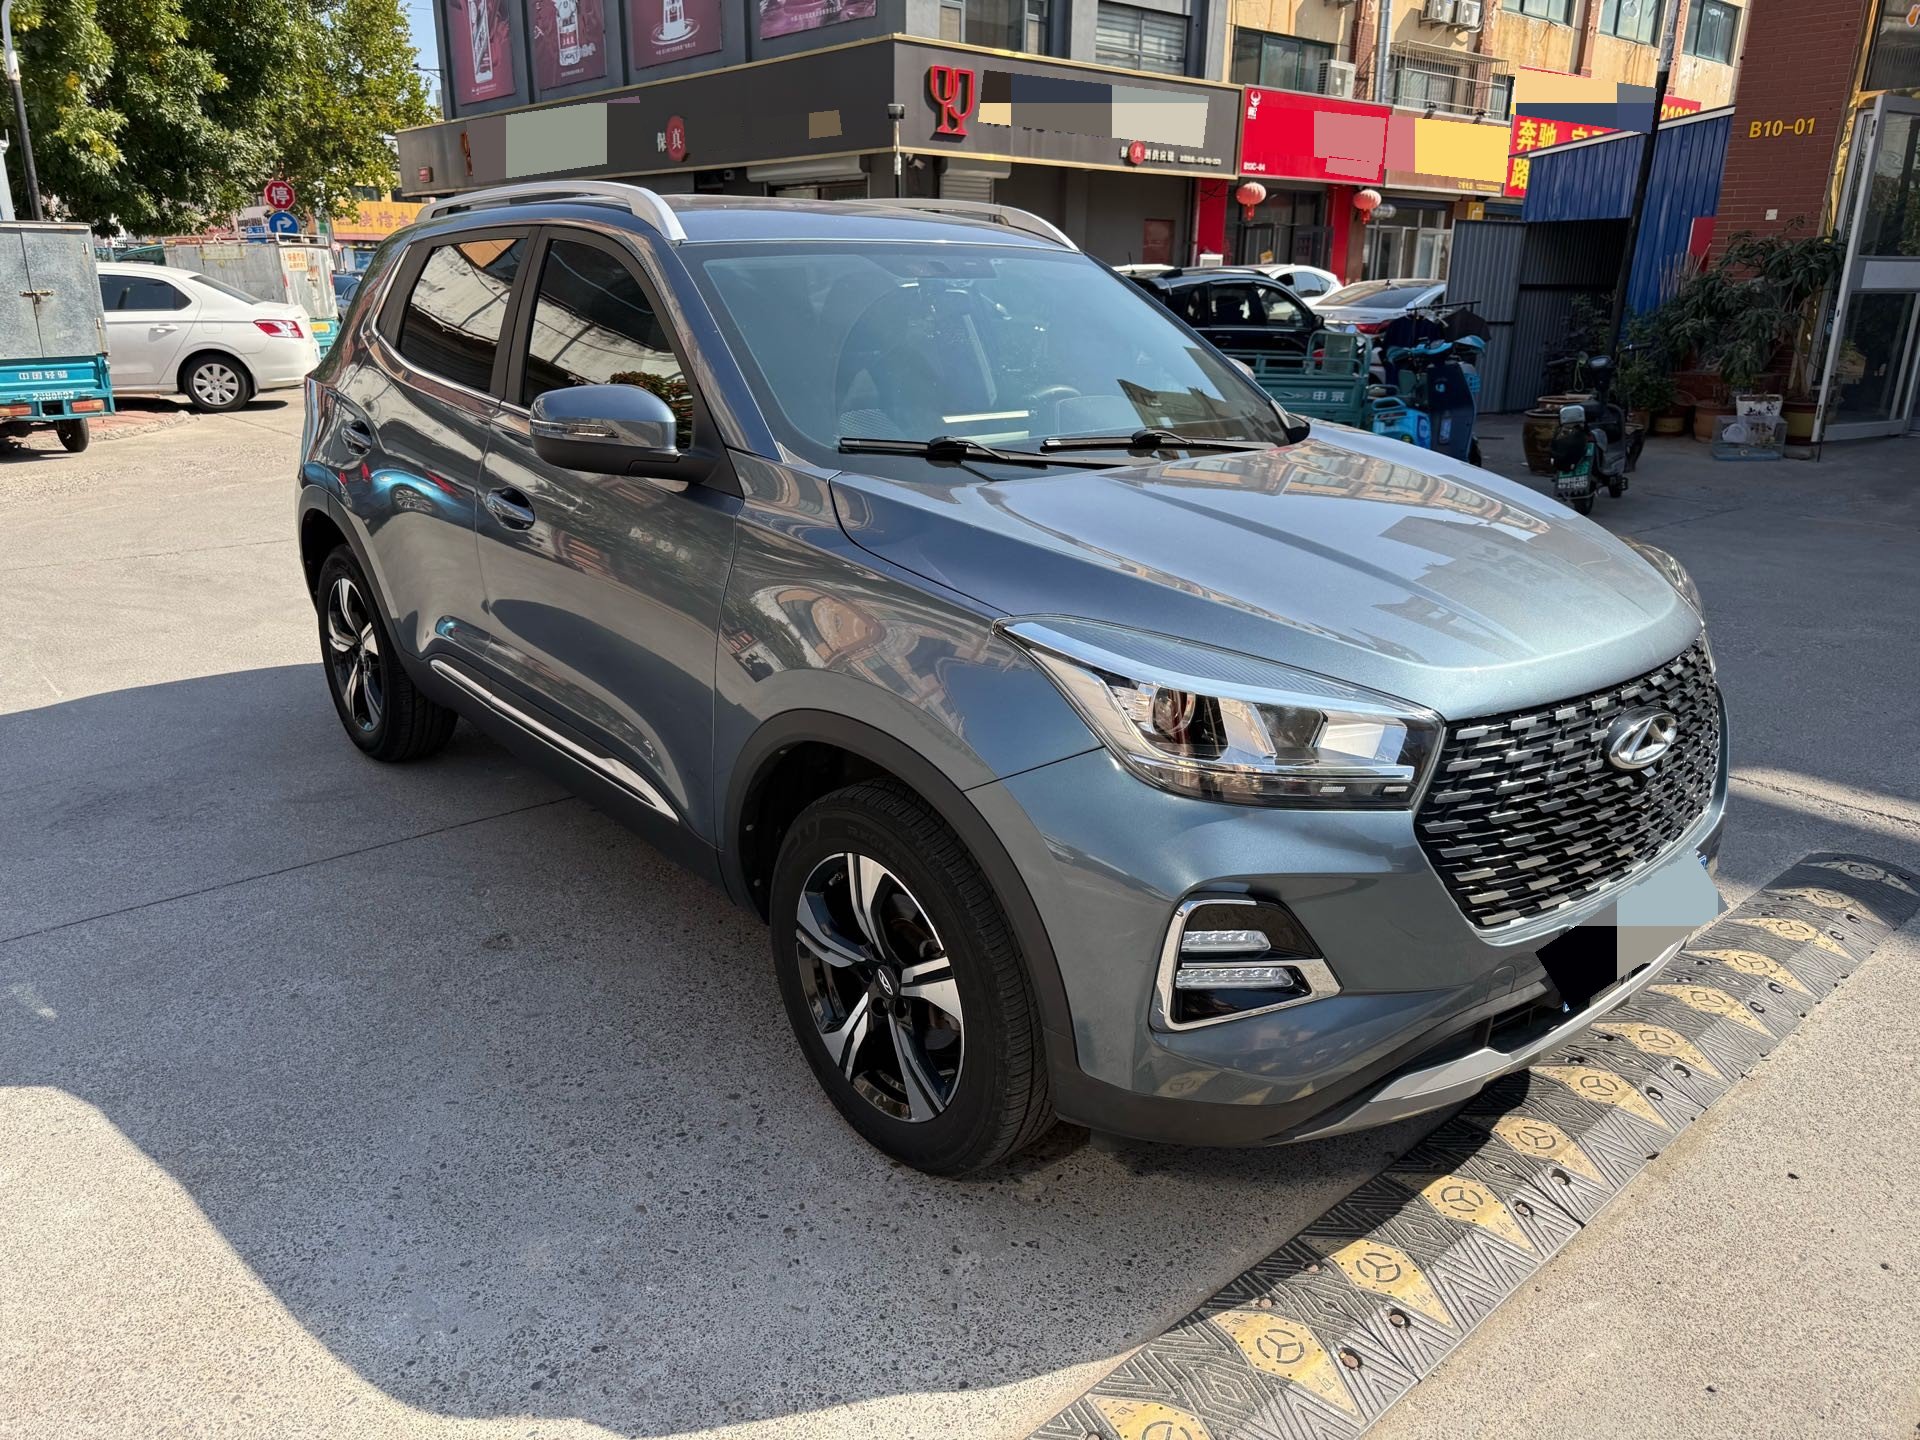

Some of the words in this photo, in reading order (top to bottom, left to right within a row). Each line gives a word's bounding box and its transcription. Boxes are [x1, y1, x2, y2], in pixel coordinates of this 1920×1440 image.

[1517, 119, 1557, 150] 奔驰
[1748, 117, 1816, 138] B10-01
[1510, 157, 1530, 189] 路
[271, 186, 290, 205] 停
